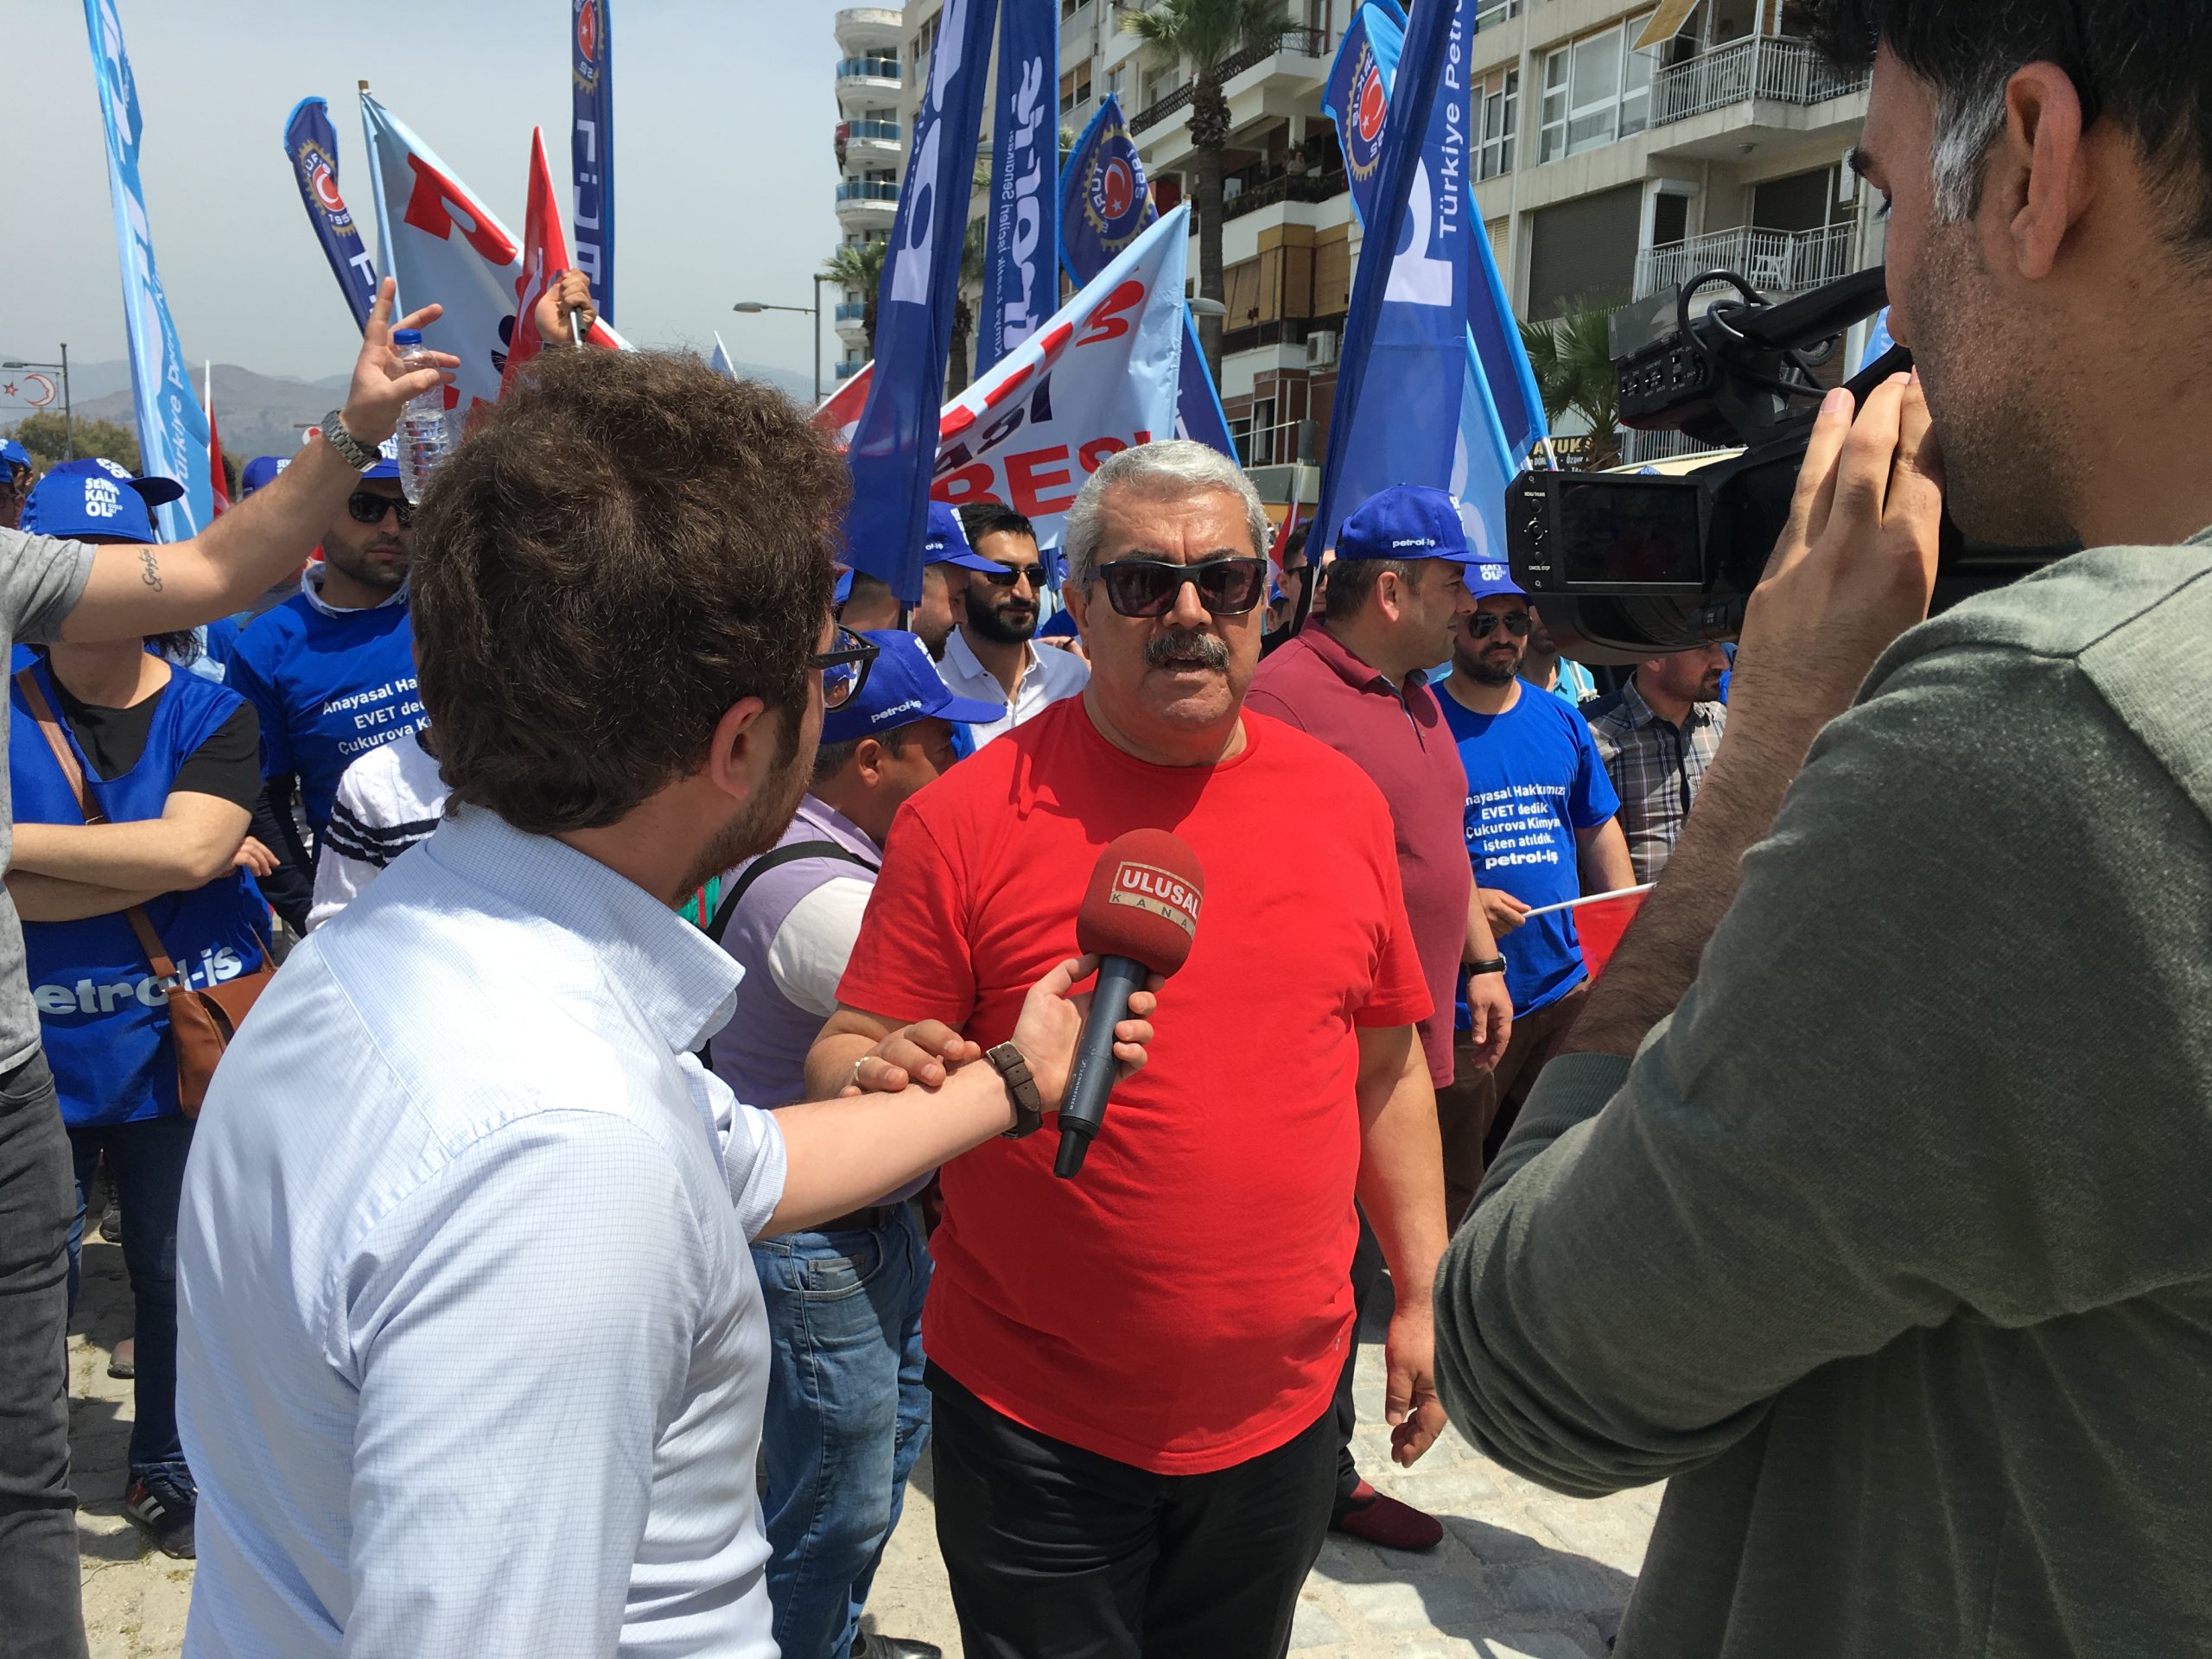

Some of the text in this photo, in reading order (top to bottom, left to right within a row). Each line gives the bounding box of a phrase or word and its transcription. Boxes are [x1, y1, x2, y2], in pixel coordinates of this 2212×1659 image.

[1439, 102, 1463, 239] Türkiye
[322, 683, 394, 715] Anayasal
[353, 705, 397, 730] EVET
[338, 723, 415, 755] Çukurova
[1465, 786, 1513, 807] nayasal
[1481, 802, 1548, 821] EVET dedik
[1465, 820, 1527, 840] Çukurova
[1483, 838, 1516, 853] işten
[1484, 849, 1559, 870] petrol-iş
[1122, 869, 1198, 921] ULUSAL
